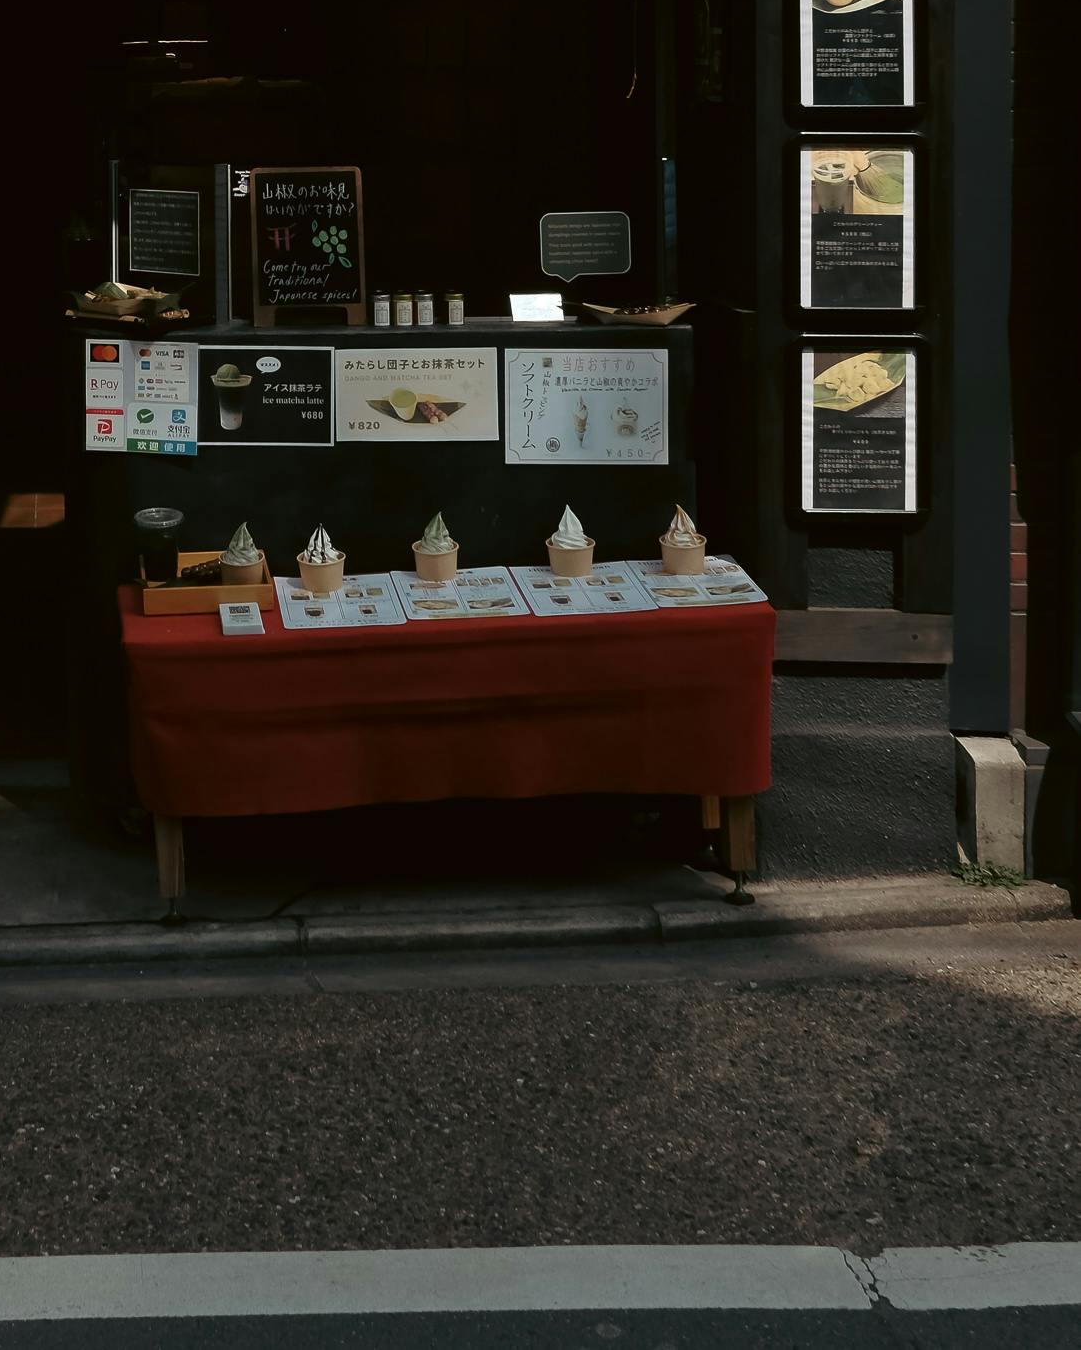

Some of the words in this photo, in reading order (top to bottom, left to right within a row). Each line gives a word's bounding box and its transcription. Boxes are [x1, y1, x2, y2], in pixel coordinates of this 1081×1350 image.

[263, 183, 350, 200] 山椒のお味見
[263, 259, 291, 274] Come
[292, 260, 307, 275] try
[310, 263, 331, 272] our
[268, 274, 330, 287] traditional
[269, 289, 318, 304] Japanese
[344, 358, 485, 370] みたらし団子とお抹茶セット
[562, 357, 636, 372] 当店おすすめ
[90, 379, 98, 390] R
[100, 379, 119, 390] Pay
[263, 383, 323, 392] アイス抹茶ラテ
[276, 396, 305, 405] matcha
[307, 396, 324, 405] latte
[521, 361, 536, 449] ソフトクリーム
[301, 411, 324, 420] ¥680
[348, 421, 381, 430] ¥820
[93, 435, 117, 443] PayPay
